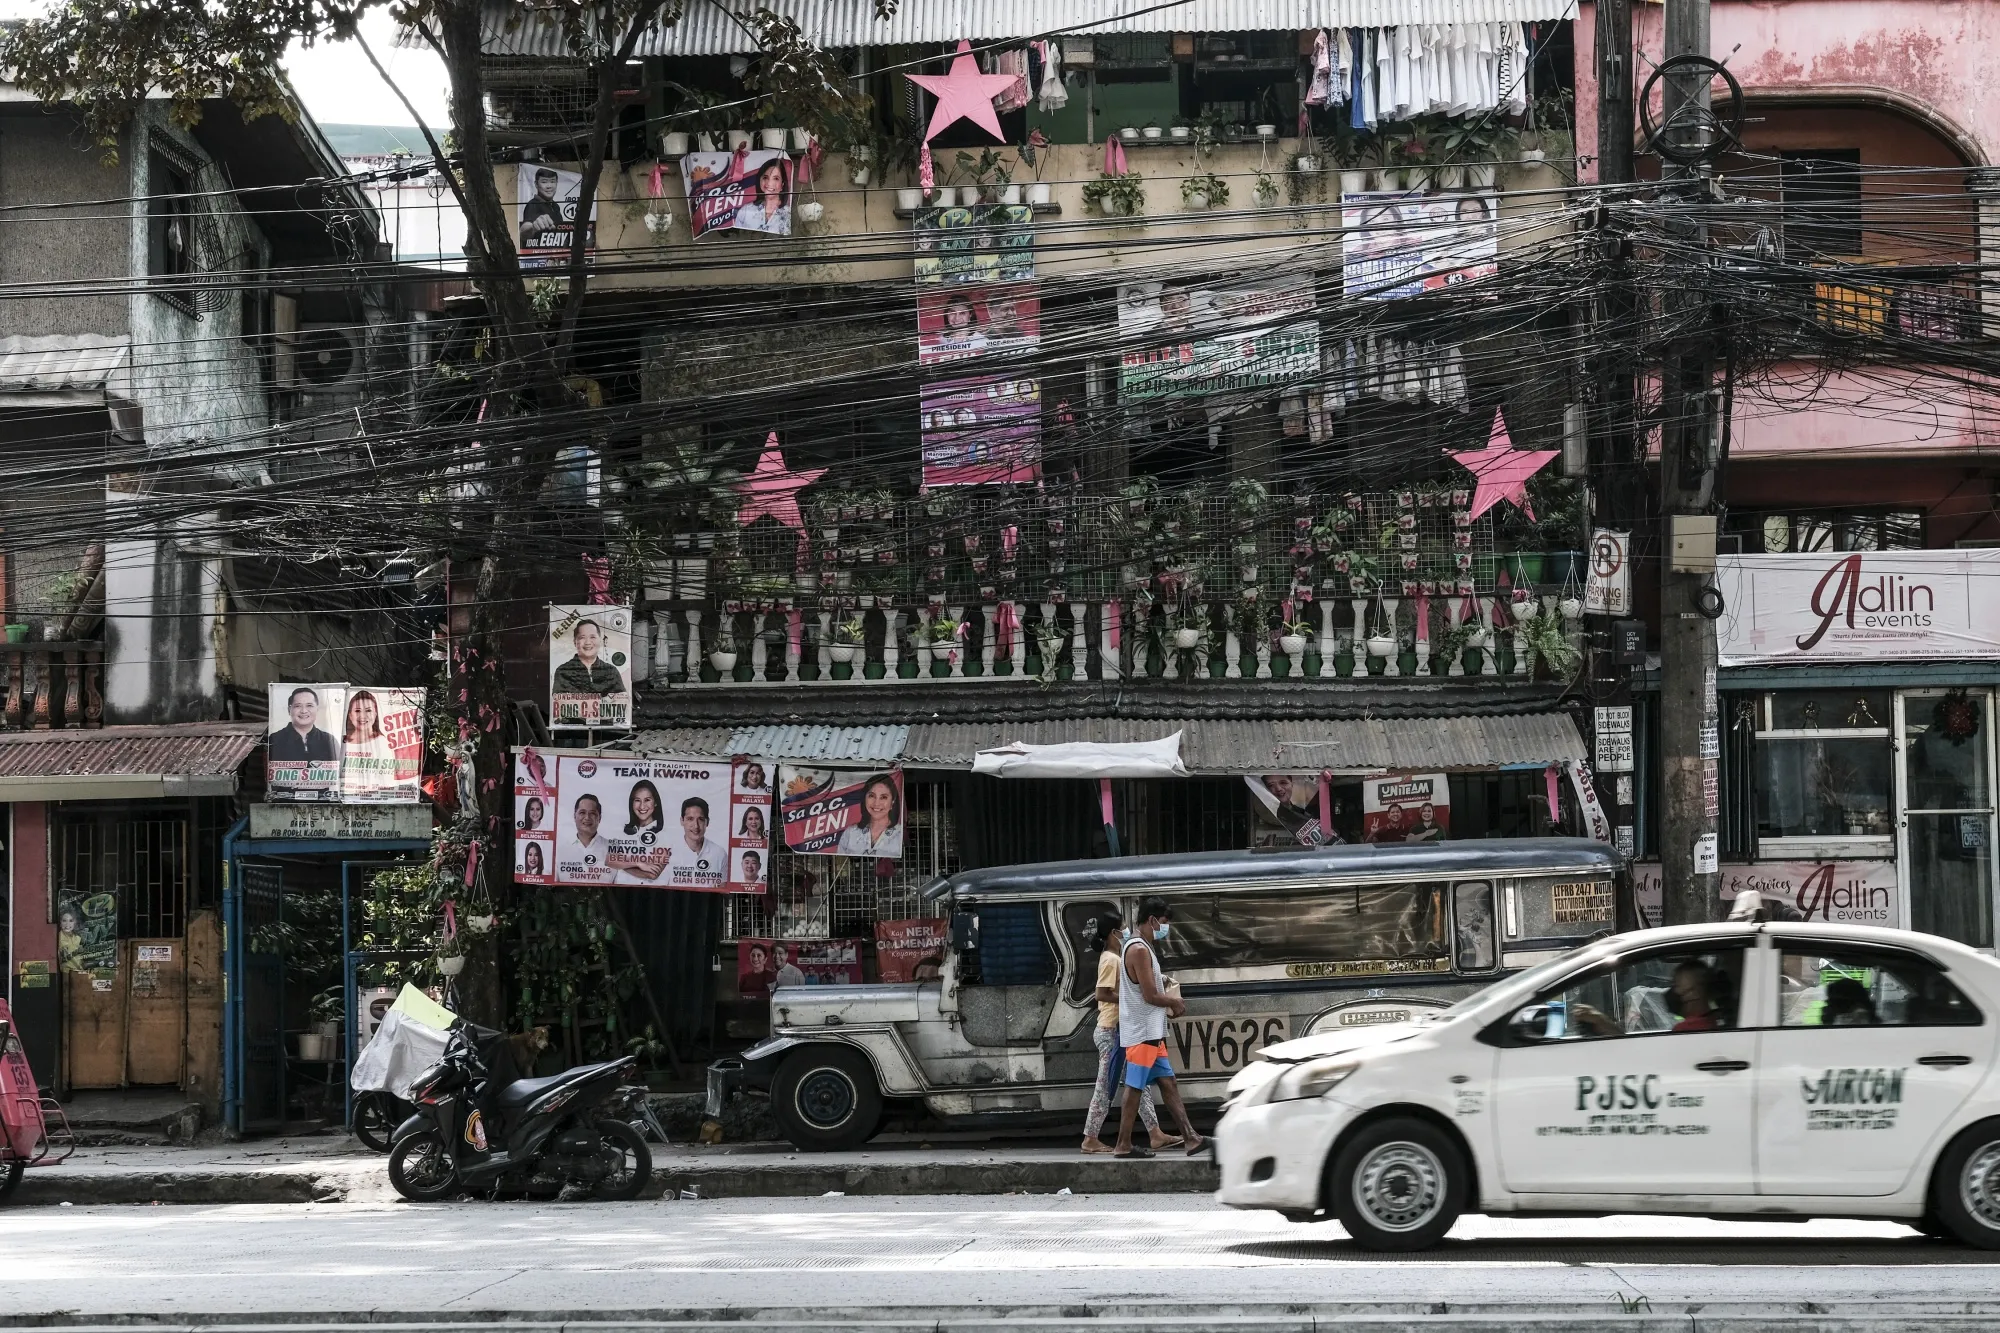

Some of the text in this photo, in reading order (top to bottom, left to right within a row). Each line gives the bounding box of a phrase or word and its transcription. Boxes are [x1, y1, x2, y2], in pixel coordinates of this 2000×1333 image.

[705, 190, 745, 219] LENI
[707, 208, 735, 228] Tayo!
[944, 211, 967, 227] 12
[540, 231, 568, 247] EGAY
[1448, 274, 1462, 284] #3
[1588, 586, 1621, 598] PARKING
[1588, 596, 1599, 604] THIS
[1795, 554, 1934, 650] Adlin
[1865, 612, 1932, 628] events
[553, 701, 579, 719] BONG
[592, 701, 628, 718] SUNTAY
[383, 708, 419, 732] STAY
[386, 726, 422, 750] SAFE
[1598, 753, 1631, 762] PEOPLE
[613, 767, 710, 779] TEAM KW4TRO
[787, 797, 847, 823] Sa Q.C.
[803, 808, 849, 840] LENI
[644, 833, 653, 844] 3
[805, 832, 837, 851] Tayo!
[1963, 833, 1983, 846] OPEN
[608, 846, 646, 855] MAYOR
[587, 855, 594, 864] 2
[609, 855, 670, 864] BELMONTE
[698, 860, 707, 869] 4
[673, 870, 722, 879] VICE MAYOR
[695, 877, 722, 885] SOTTO
[1553, 884, 1575, 897] LTFRB
[1576, 883, 1592, 895] 24/7
[1747, 875, 1792, 894] Services
[1796, 864, 1889, 922] Adlin
[1570, 909, 1596, 922] CAPACITY
[1837, 909, 1888, 920] events
[891, 926, 934, 938] Kay NERI
[11, 1065, 29, 1086] 135
[1575, 1074, 1662, 1111] PJSC
